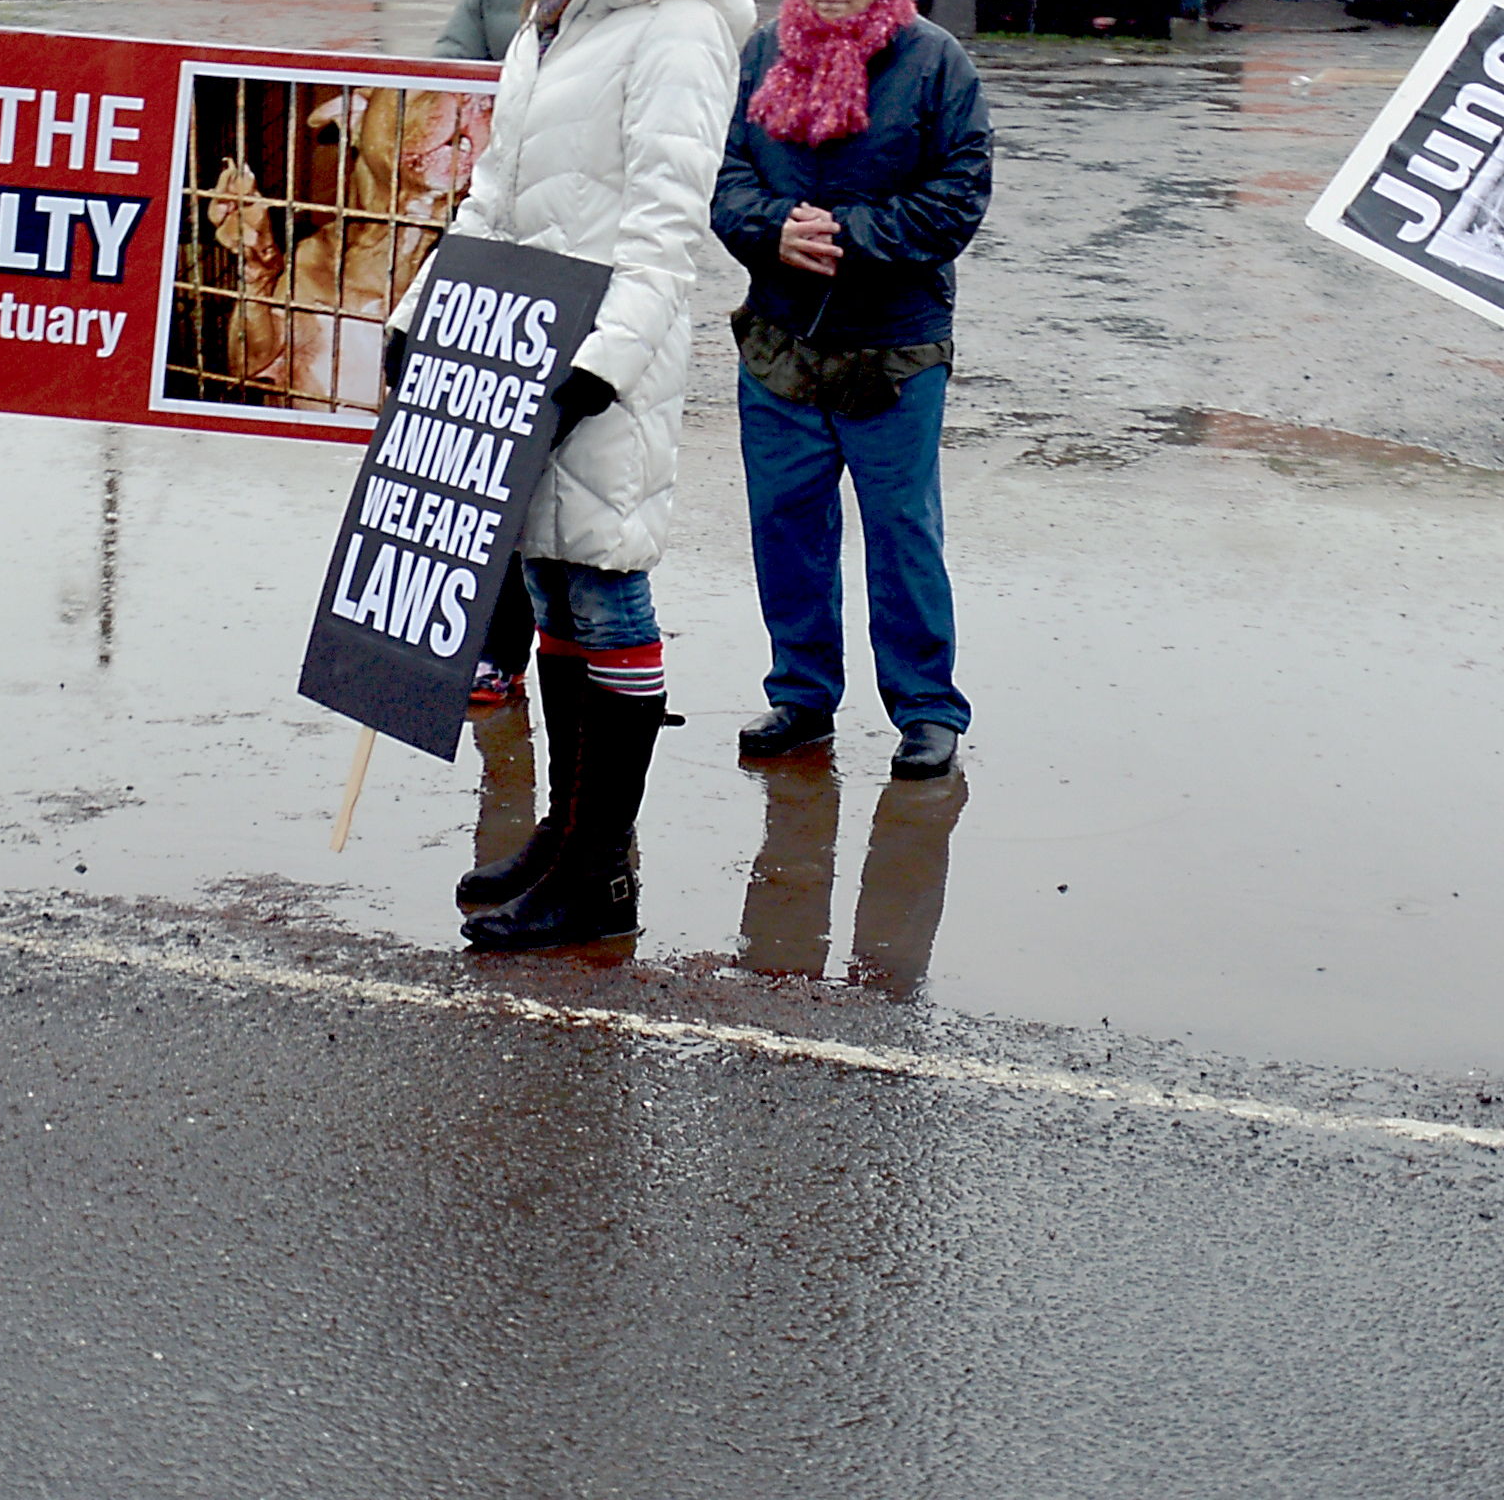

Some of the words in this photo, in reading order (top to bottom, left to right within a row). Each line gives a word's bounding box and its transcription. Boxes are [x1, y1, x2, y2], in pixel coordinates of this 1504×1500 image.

[416, 279, 557, 380] FORKS,
[397, 353, 546, 436] ENFORCE
[376, 410, 511, 501] ANIMAL
[358, 475, 501, 566] WELFARE
[331, 533, 478, 657] LAWS
